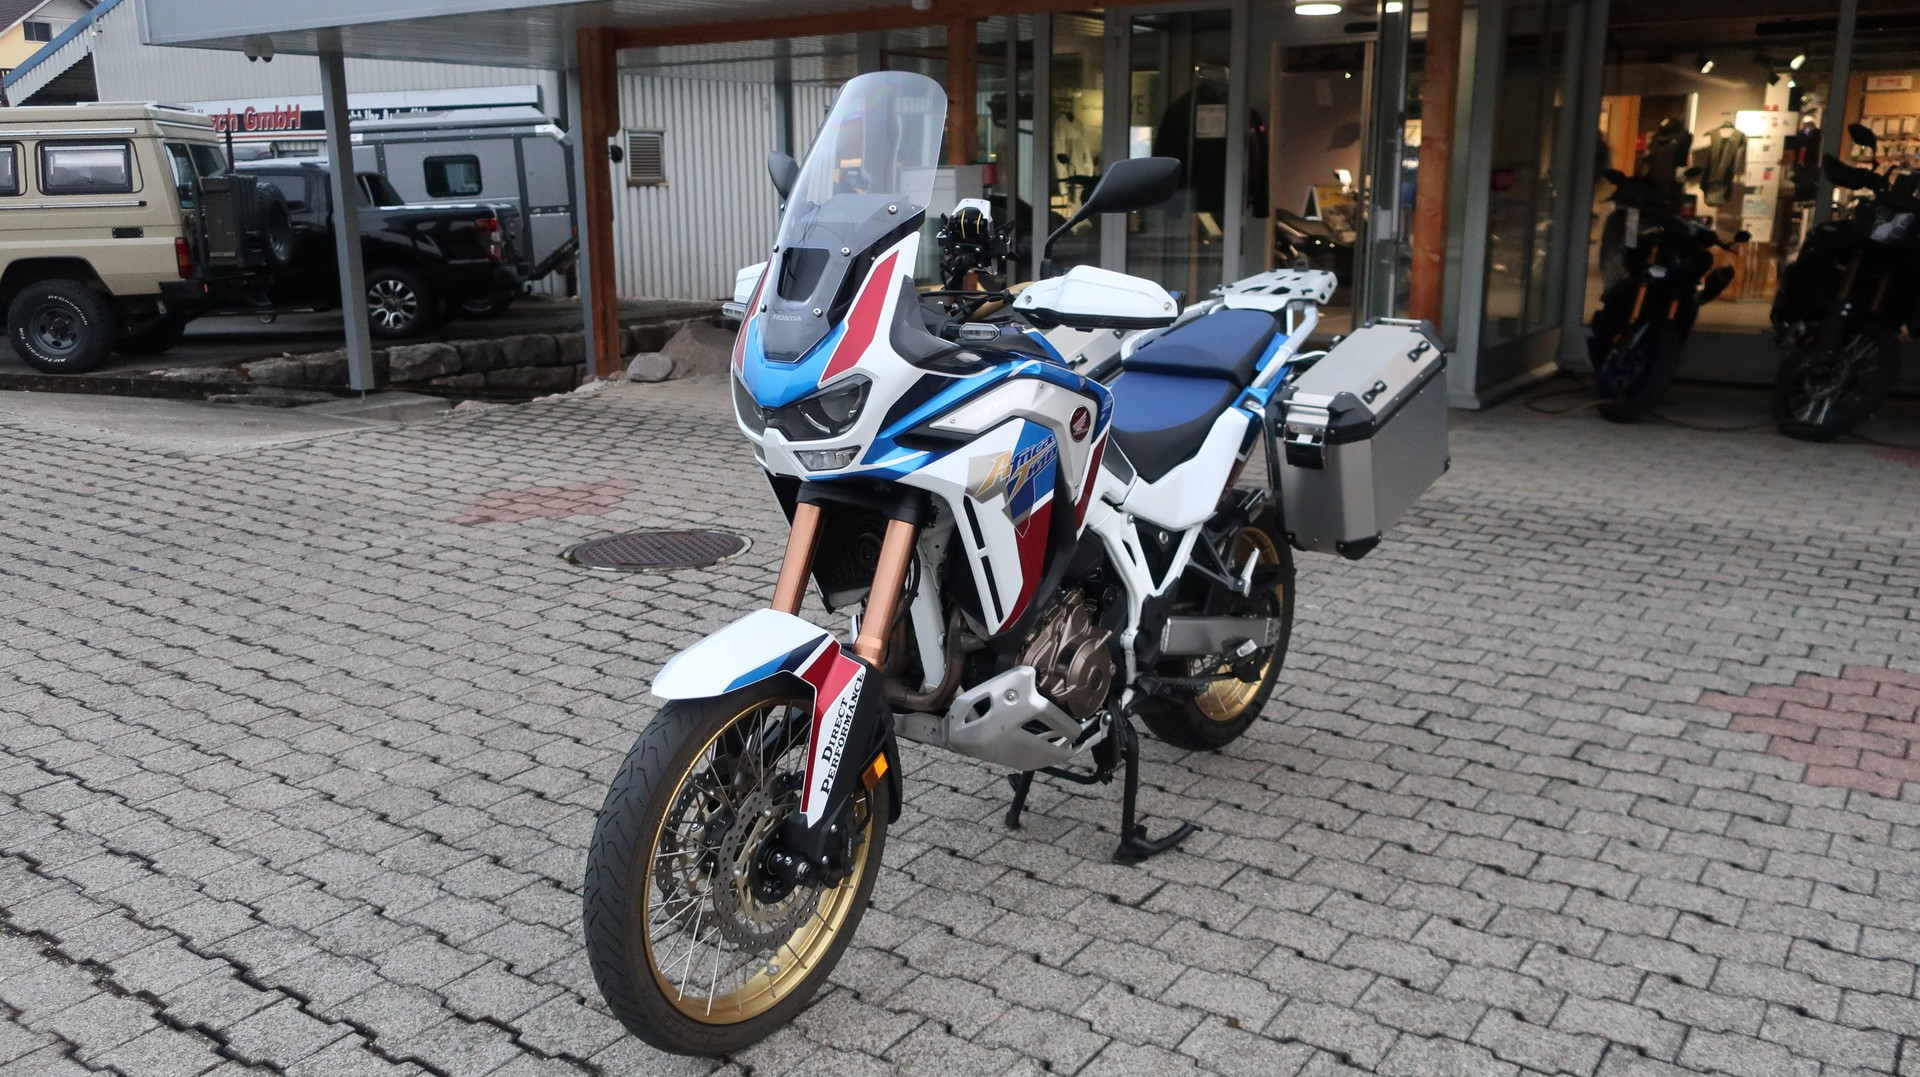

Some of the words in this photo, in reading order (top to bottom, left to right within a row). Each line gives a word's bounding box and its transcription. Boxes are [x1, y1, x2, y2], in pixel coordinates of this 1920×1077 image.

[243, 104, 301, 131] GmbH
[973, 434, 1056, 498] Africa
[820, 672, 865, 796] PERFORMANCE
[821, 697, 849, 764] DIRECT
